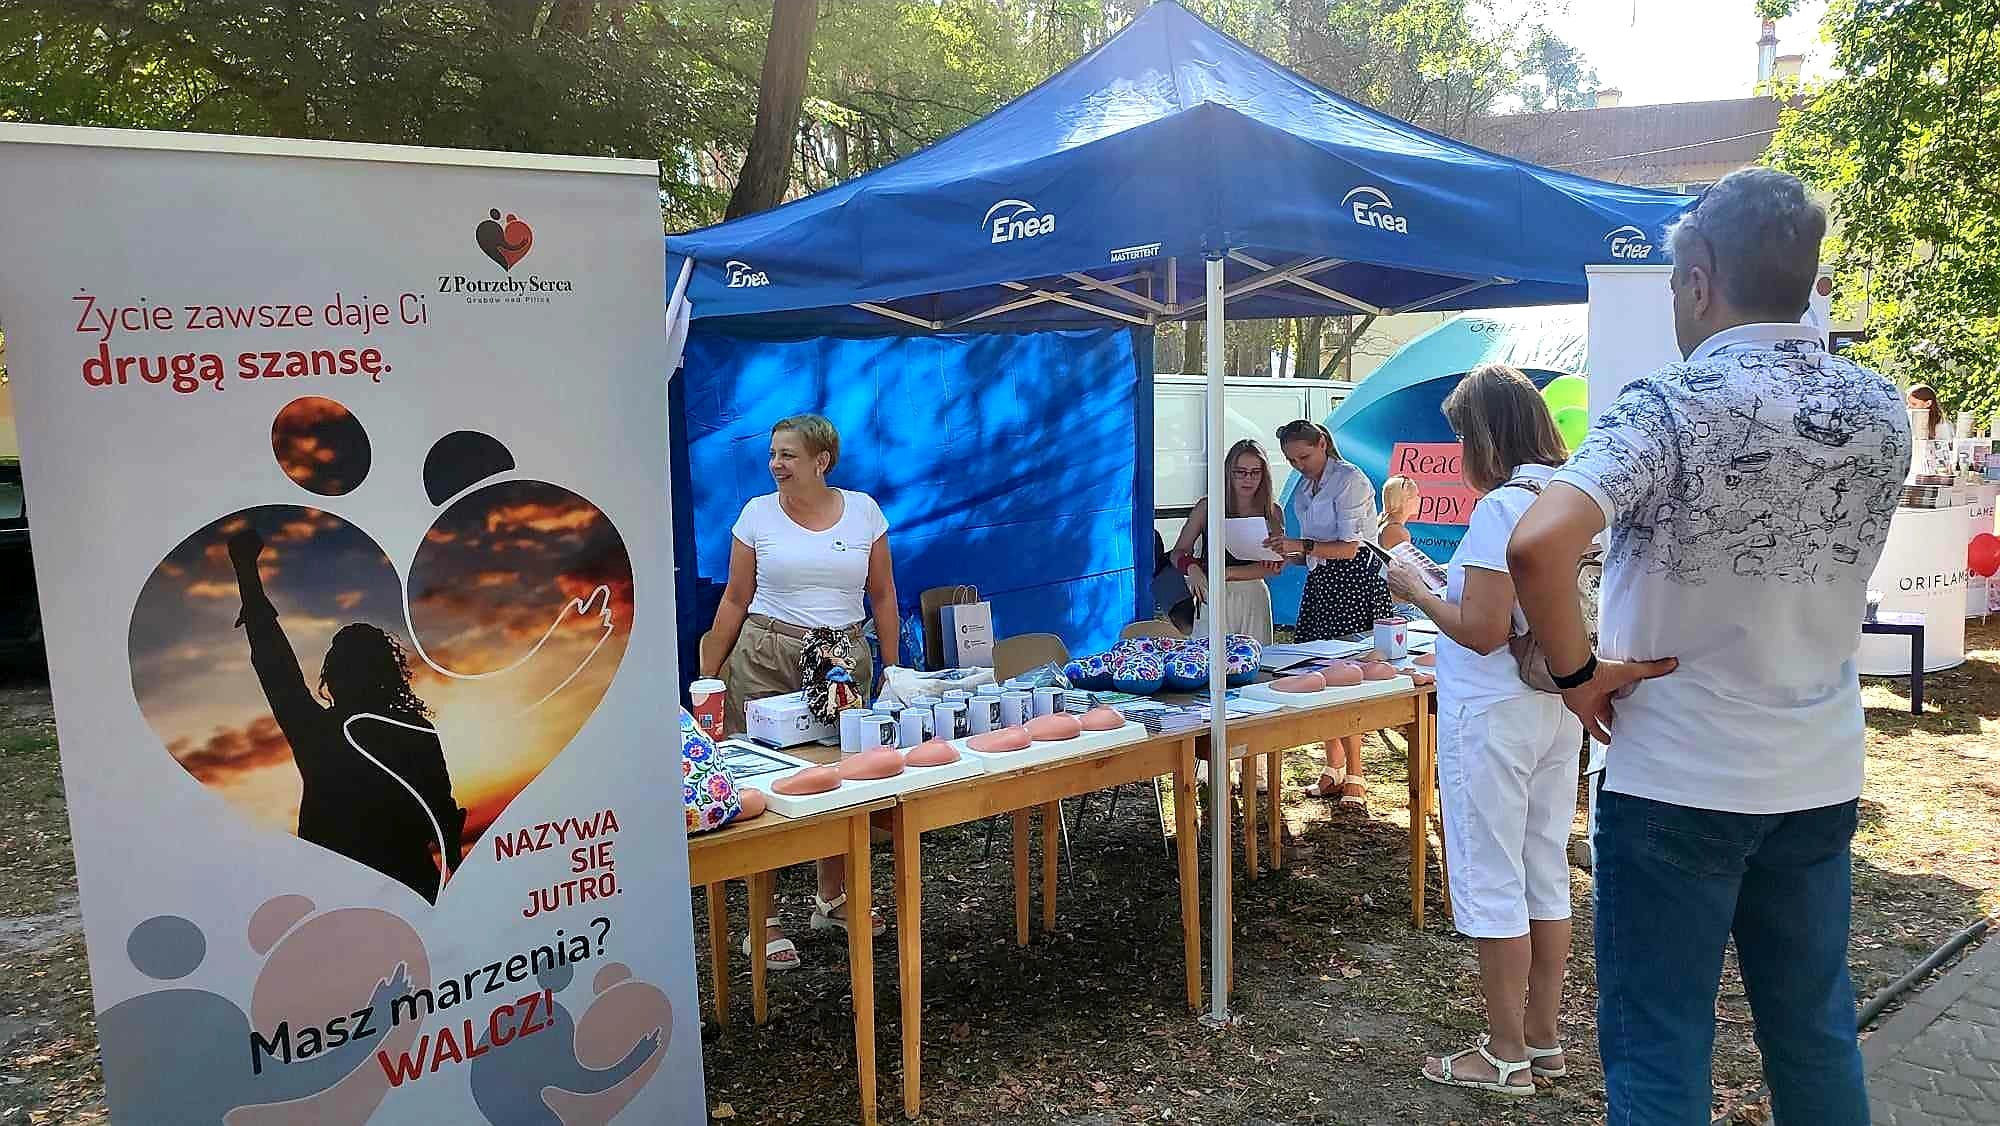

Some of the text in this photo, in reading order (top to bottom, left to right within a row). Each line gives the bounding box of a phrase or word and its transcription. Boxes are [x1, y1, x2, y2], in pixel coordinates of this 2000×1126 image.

[991, 213, 1055, 243] Enea
[1353, 201, 1408, 234] Enea
[1612, 237, 1653, 258] Enea
[439, 275, 572, 296] Z Potrzeby Serca
[728, 270, 770, 288] Enea
[72, 287, 427, 342] Życie zawsze daje Ci
[82, 342, 393, 394] drugą szansę.
[1400, 447, 1462, 474] Reac
[1417, 496, 1467, 523] ppy
[494, 809, 620, 862] NAZYWA
[571, 840, 615, 874] SIĘ
[522, 872, 623, 918] JUTRO.
[250, 916, 612, 1075] Masz marzenia?
[377, 988, 555, 1088] WALCZ!
